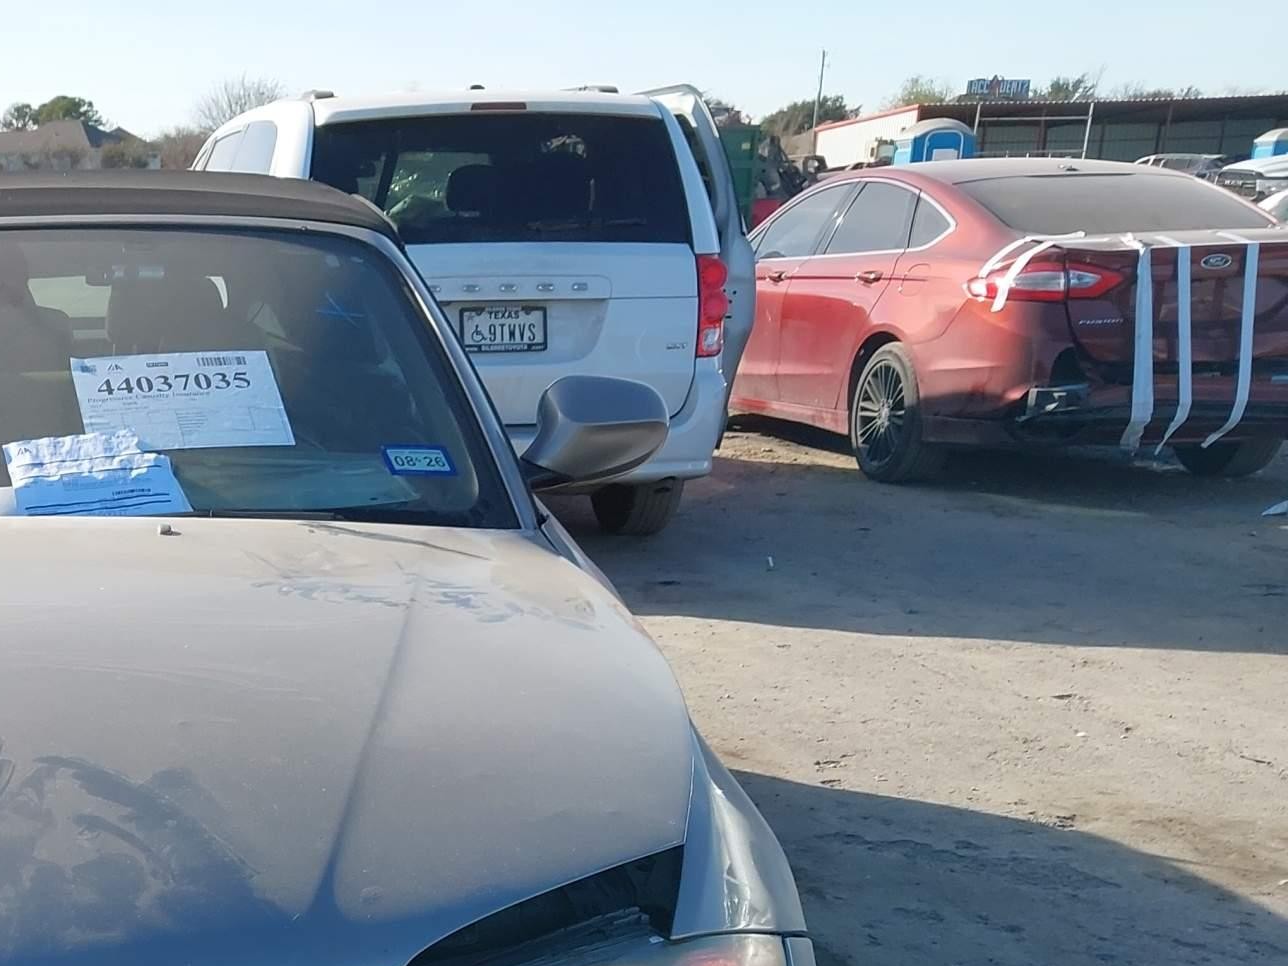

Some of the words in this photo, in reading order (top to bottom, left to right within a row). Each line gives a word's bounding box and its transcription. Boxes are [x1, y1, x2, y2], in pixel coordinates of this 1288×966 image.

[971, 80, 1029, 95] ACCDENT?
[488, 310, 520, 320] TEXAS
[488, 323, 536, 342] 9TWVS
[97, 371, 251, 395] 44037035
[394, 455, 416, 467] 08
[423, 456, 446, 468] 26
